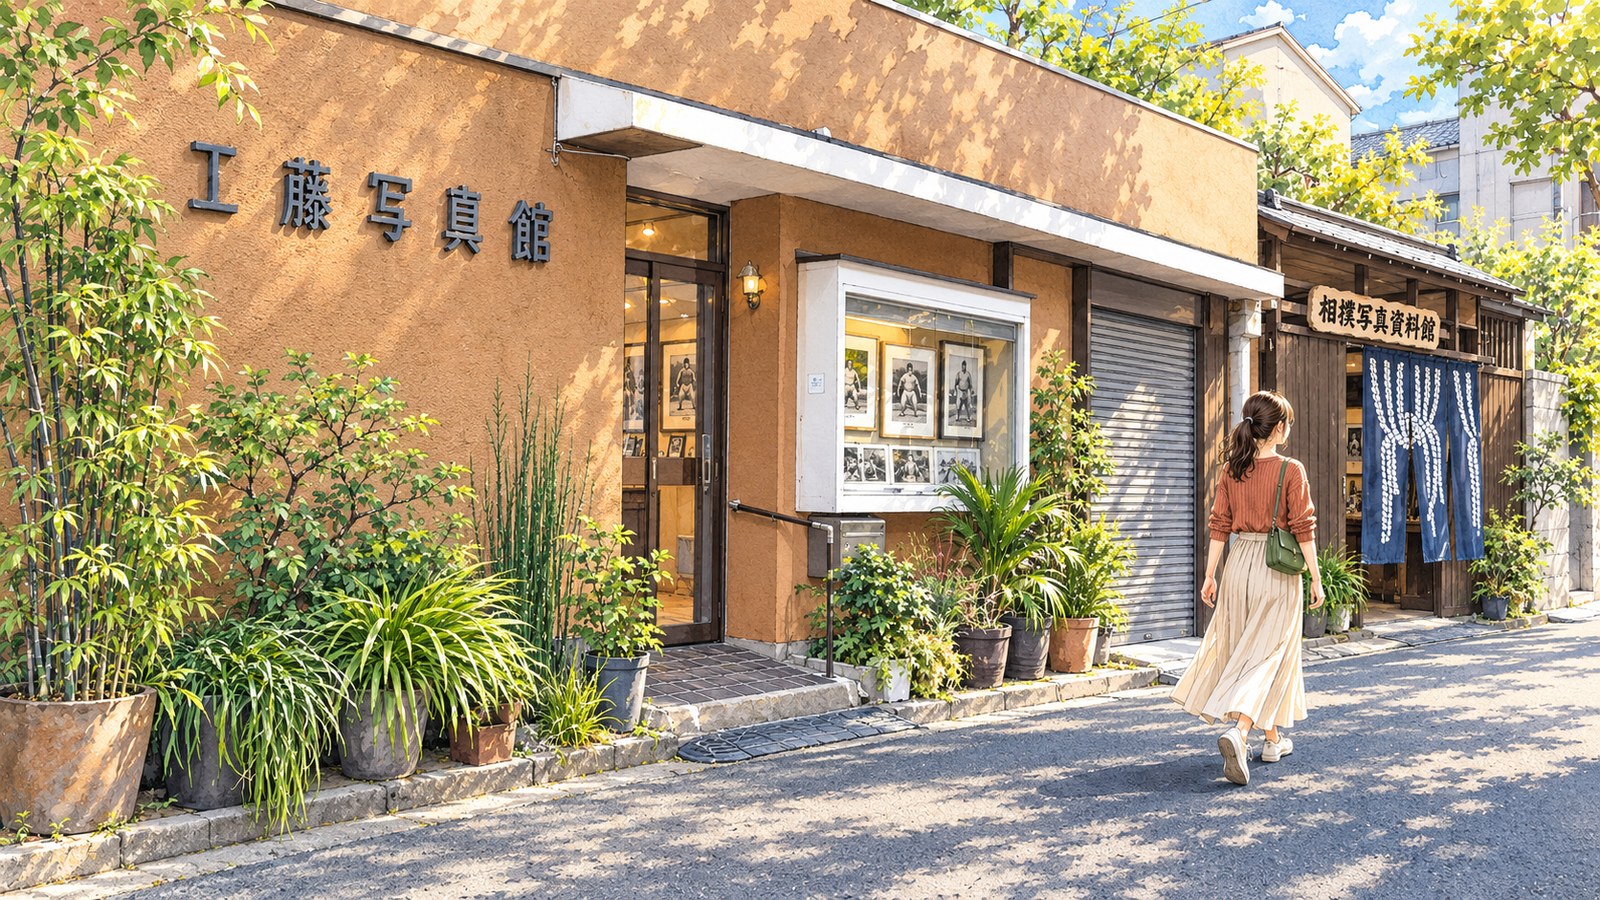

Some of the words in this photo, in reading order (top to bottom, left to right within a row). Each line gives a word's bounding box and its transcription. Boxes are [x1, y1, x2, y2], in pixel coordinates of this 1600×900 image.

[187, 140, 554, 263] 工藤写真館
[1318, 294, 1436, 342] 相撲写真資料館
